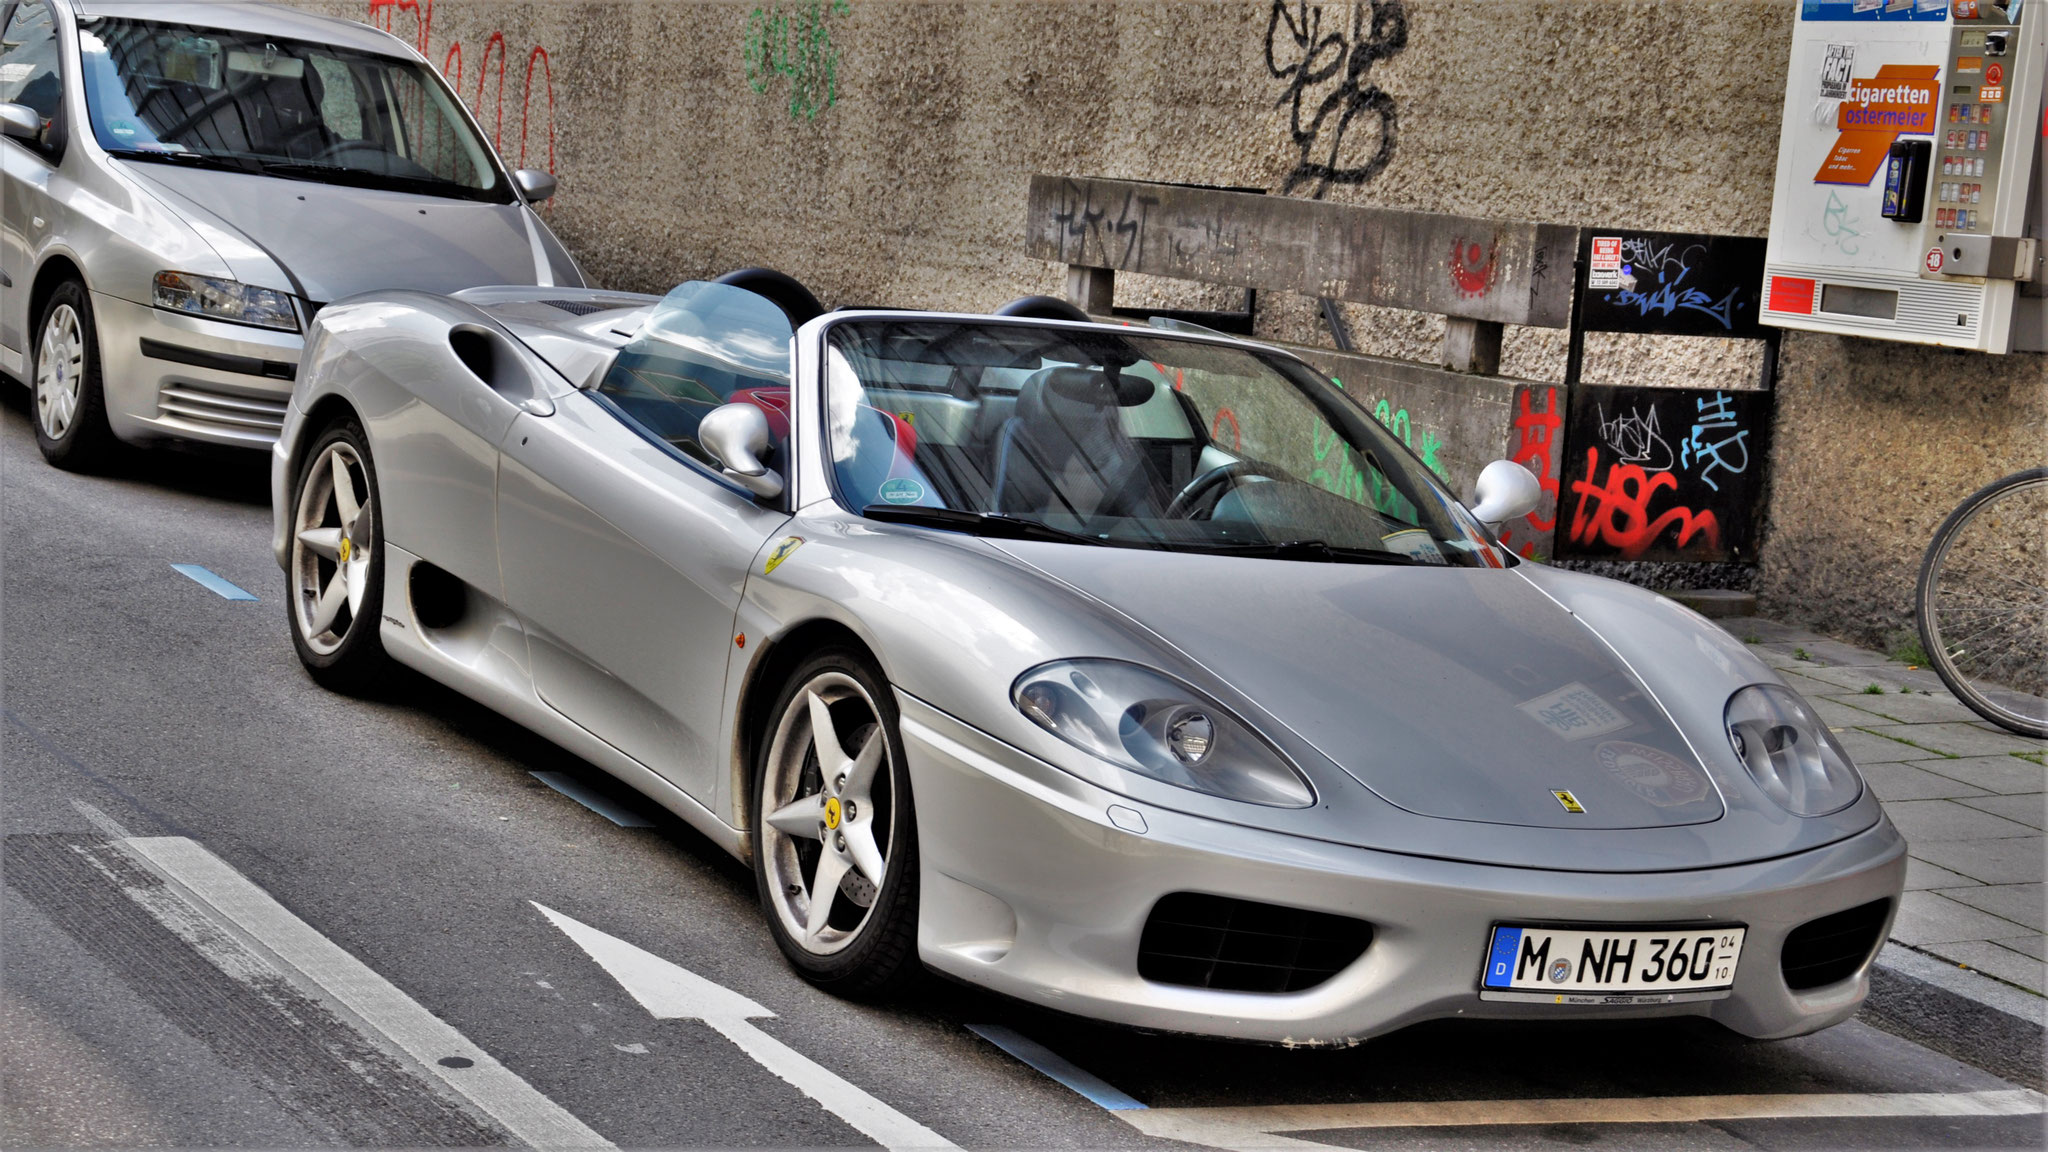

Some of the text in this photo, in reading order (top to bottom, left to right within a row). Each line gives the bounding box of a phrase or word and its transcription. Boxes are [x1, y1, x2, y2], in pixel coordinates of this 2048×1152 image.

[1822, 57, 1852, 82] FACT
[1848, 82, 1930, 108] cigaretten
[1846, 106, 1928, 126] ostermeier
[1720, 936, 1735, 949] 04
[1495, 962, 1506, 975] D
[1516, 936, 1715, 983] M NH 360
[1715, 967, 1728, 980] 10
